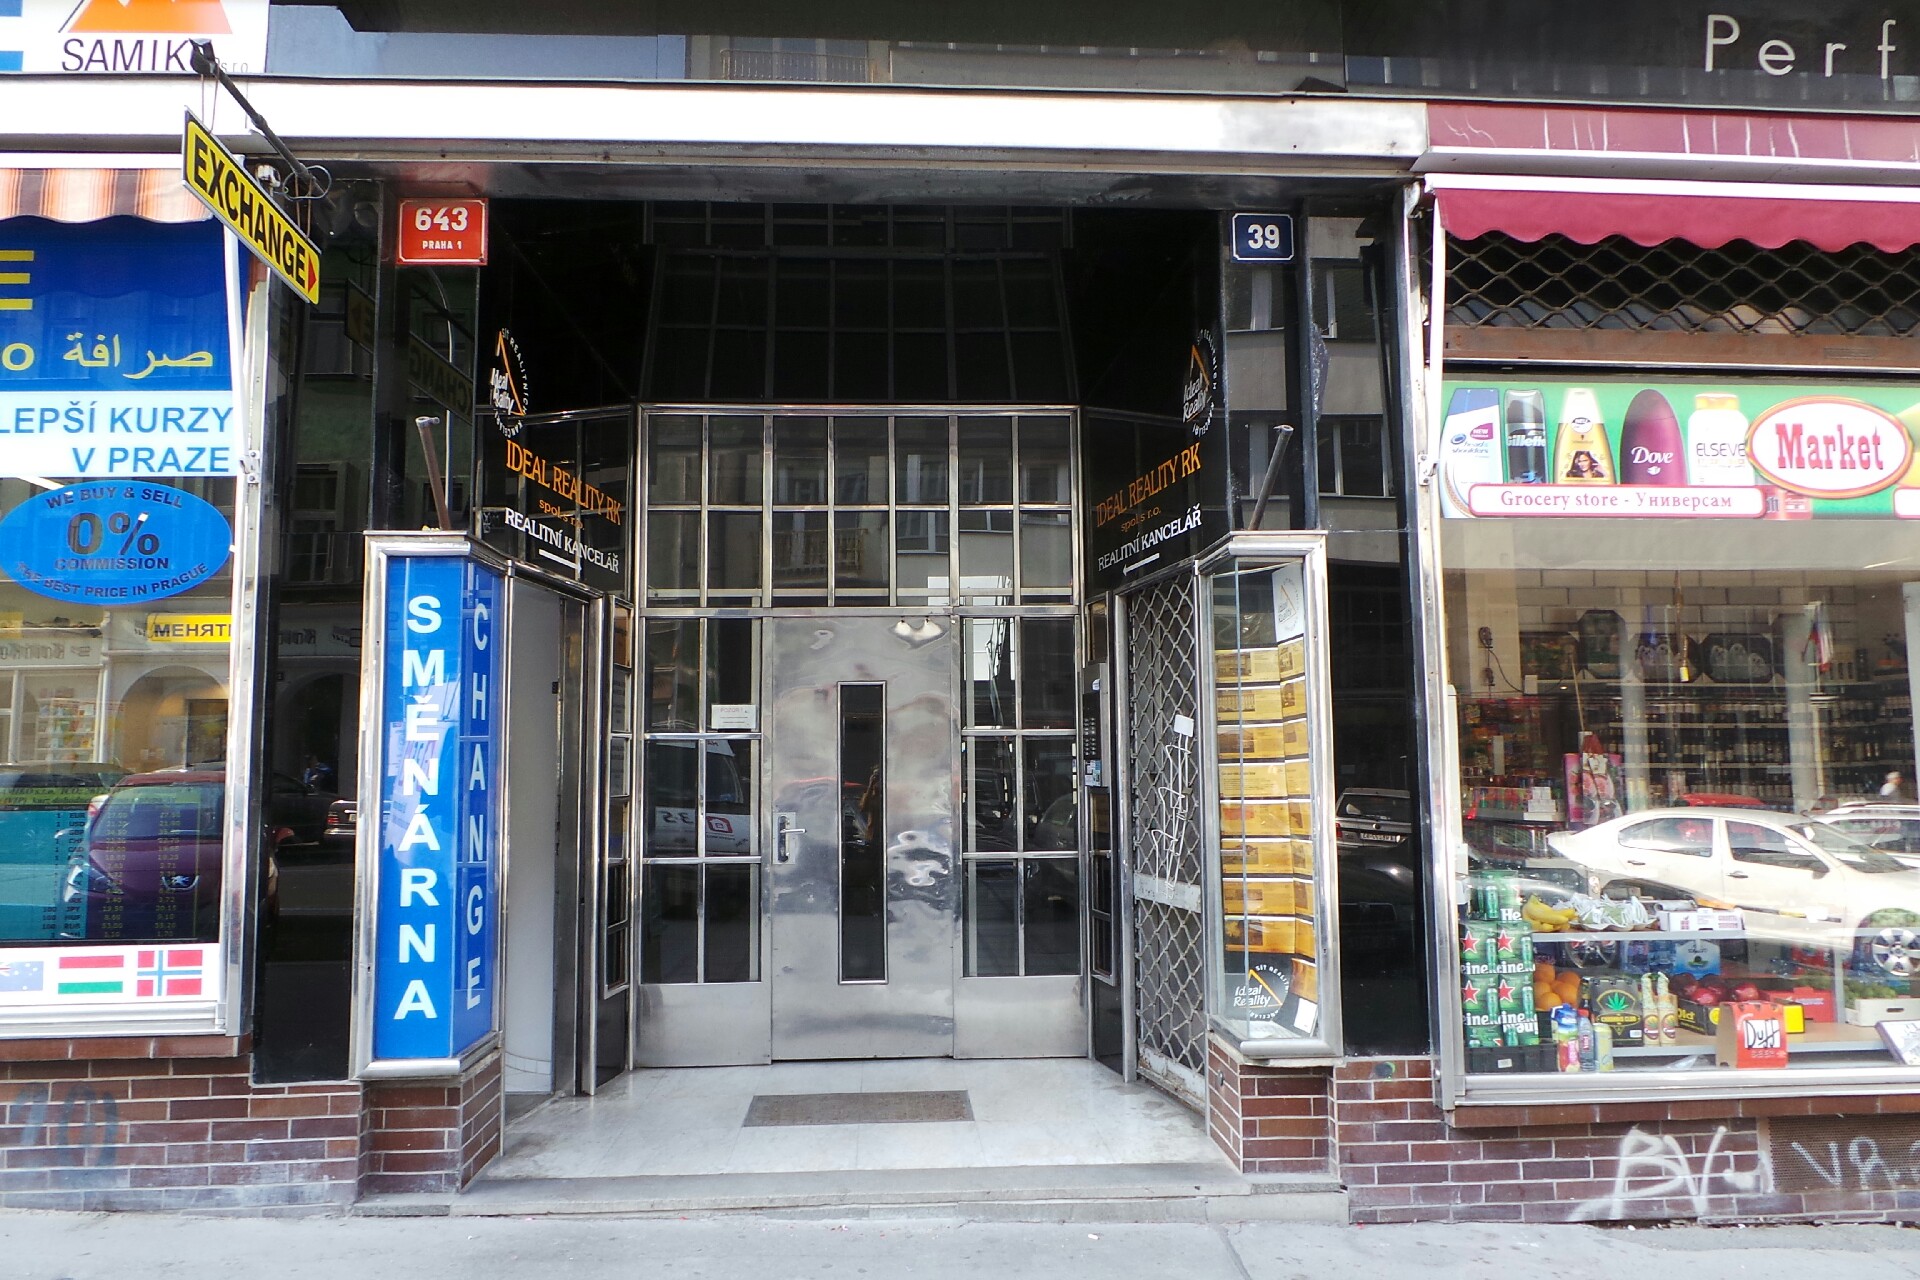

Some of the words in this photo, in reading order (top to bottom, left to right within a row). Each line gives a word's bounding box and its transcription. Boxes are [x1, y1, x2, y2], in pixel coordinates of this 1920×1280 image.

[61, 38, 220, 71] SAMIK
[1704, 14, 1896, 79] Perf
[193, 133, 307, 289] EXCHANGE
[415, 207, 468, 231] 643
[422, 240, 453, 250] PRAHA
[457, 240, 462, 250] 1
[1247, 223, 1280, 249] 39
[109, 407, 233, 433] KURZY
[72, 447, 96, 473] V
[109, 447, 230, 473] PRAZE
[1631, 447, 1674, 464] Dove
[1775, 423, 1884, 470] Market
[45, 491, 74, 509] WE
[80, 487, 117, 500] BUY
[123, 487, 135, 498] &
[141, 488, 183, 508] SELL
[506, 439, 550, 488] IDEAL
[553, 465, 605, 515] REALITY
[606, 495, 621, 526] RK
[1096, 489, 1128, 528] IDEAL
[1128, 455, 1179, 508] REALITY
[1181, 442, 1201, 478] RK
[1500, 490, 1571, 511] Grocery
[1575, 493, 1618, 506] store
[1636, 491, 1732, 512] Универсам
[67, 511, 161, 556] 0%
[504, 507, 563, 549] REALITNÍ
[564, 535, 620, 574] KANCELÁŘ
[1098, 532, 1140, 572] REALITNÍ
[1141, 502, 1202, 551] KANCELÁŘ
[44, 579, 81, 595] BEST
[84, 585, 128, 598] PRICE
[133, 584, 147, 596] IN
[151, 562, 209, 594] PRAGUE
[54, 557, 169, 571] COMMISSION
[393, 595, 445, 1020] SMĚNÁRNA
[466, 602, 489, 1011] CHANGE
[1233, 995, 1272, 1008] Reality
[1235, 984, 1263, 996] Ideal
[1744, 1018, 1781, 1050] Duff
